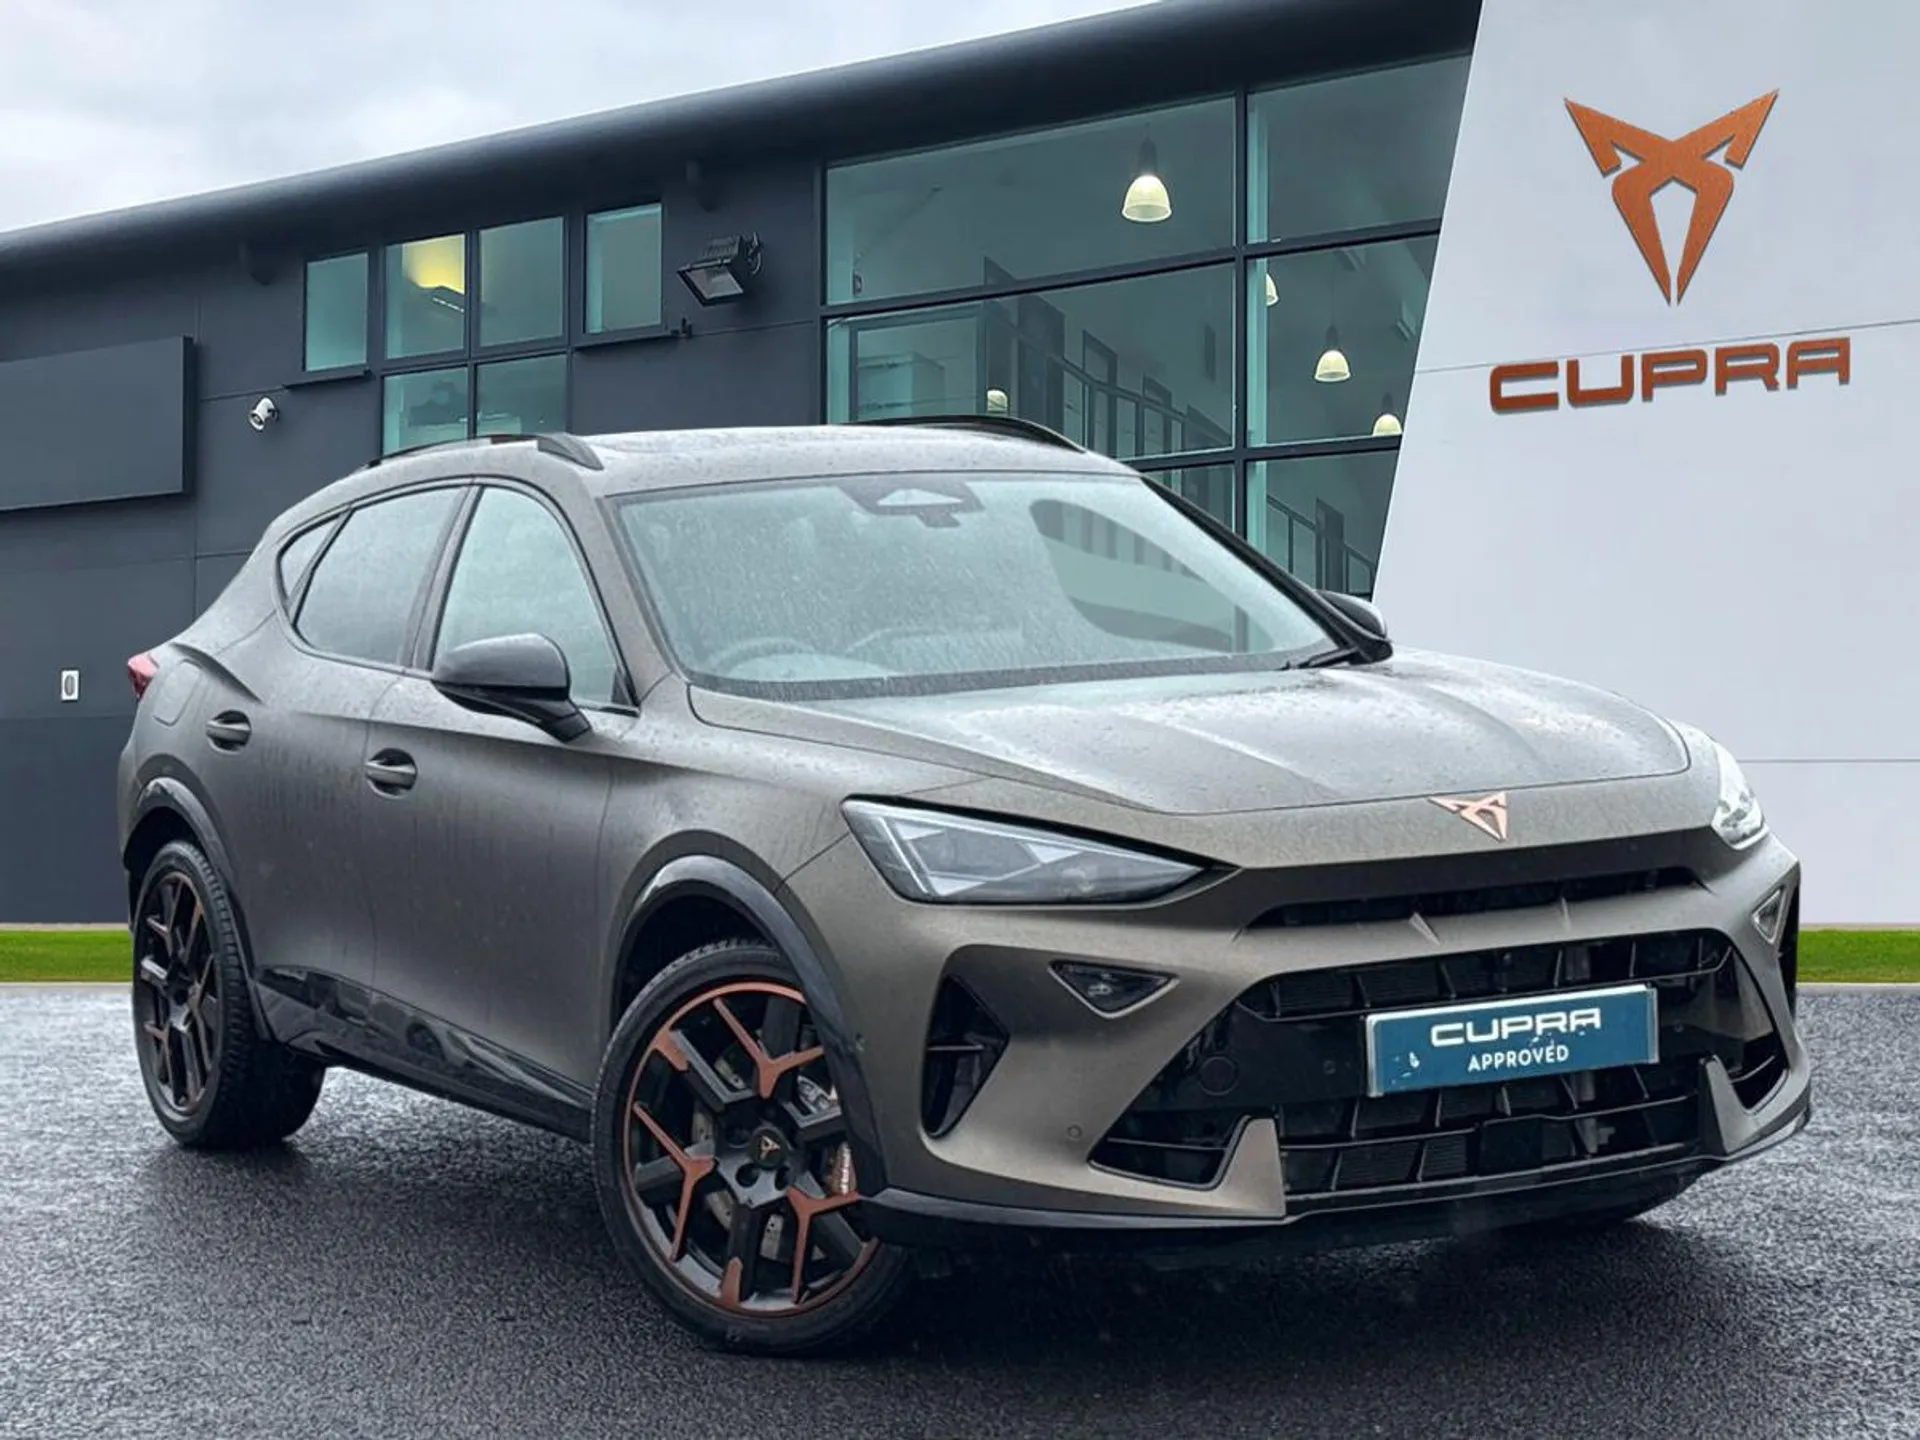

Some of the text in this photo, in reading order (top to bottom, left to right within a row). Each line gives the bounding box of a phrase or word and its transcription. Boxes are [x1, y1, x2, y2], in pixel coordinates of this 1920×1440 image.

[1490, 337, 1850, 415] CUPRA
[1431, 1008, 1601, 1047] CUPRA
[1467, 1045, 1569, 1072] APPROVED
